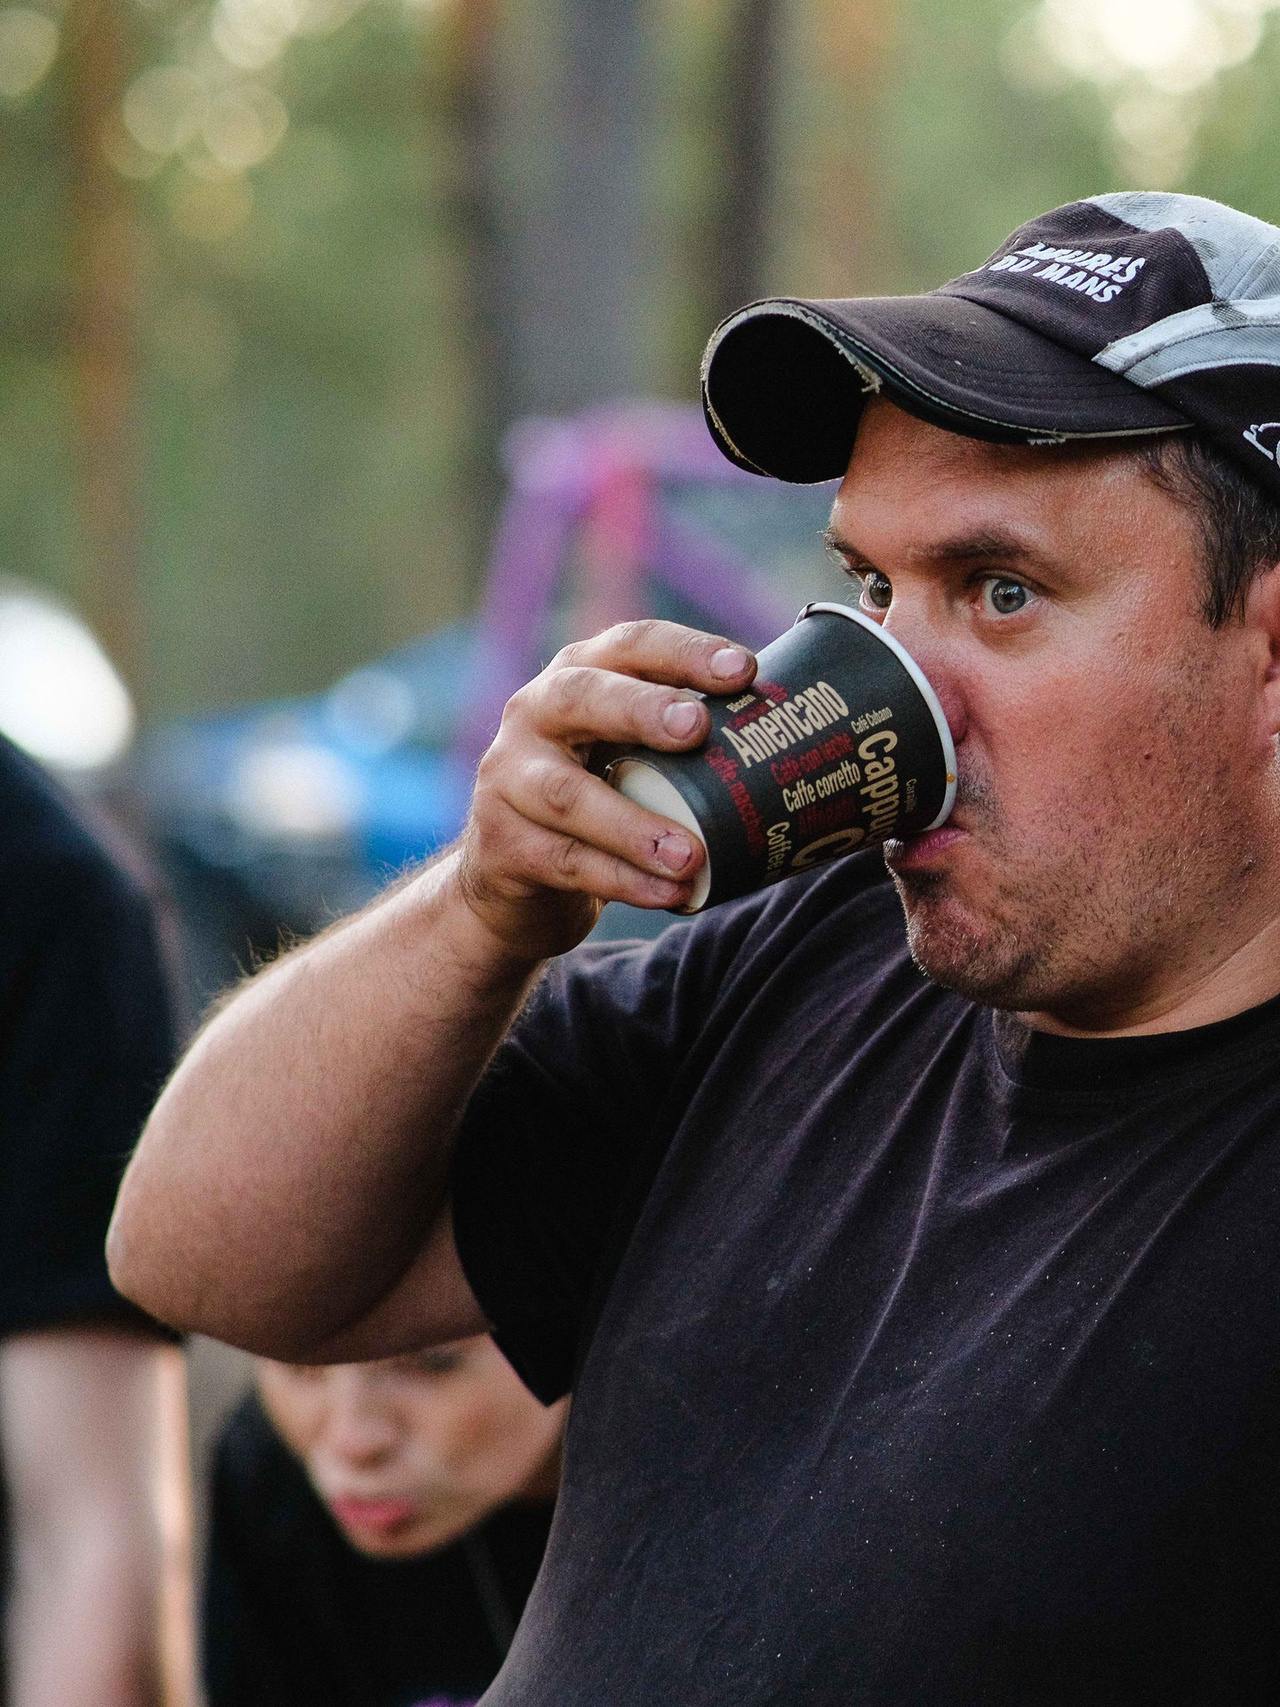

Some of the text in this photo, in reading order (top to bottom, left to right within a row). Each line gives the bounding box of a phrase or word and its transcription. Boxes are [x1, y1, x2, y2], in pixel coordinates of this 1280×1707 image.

[989, 255, 1122, 302] DU MANS
[721, 681, 849, 768] Americano
[782, 760, 861, 812] Caffe corretto
[767, 821, 792, 870] Coffee
